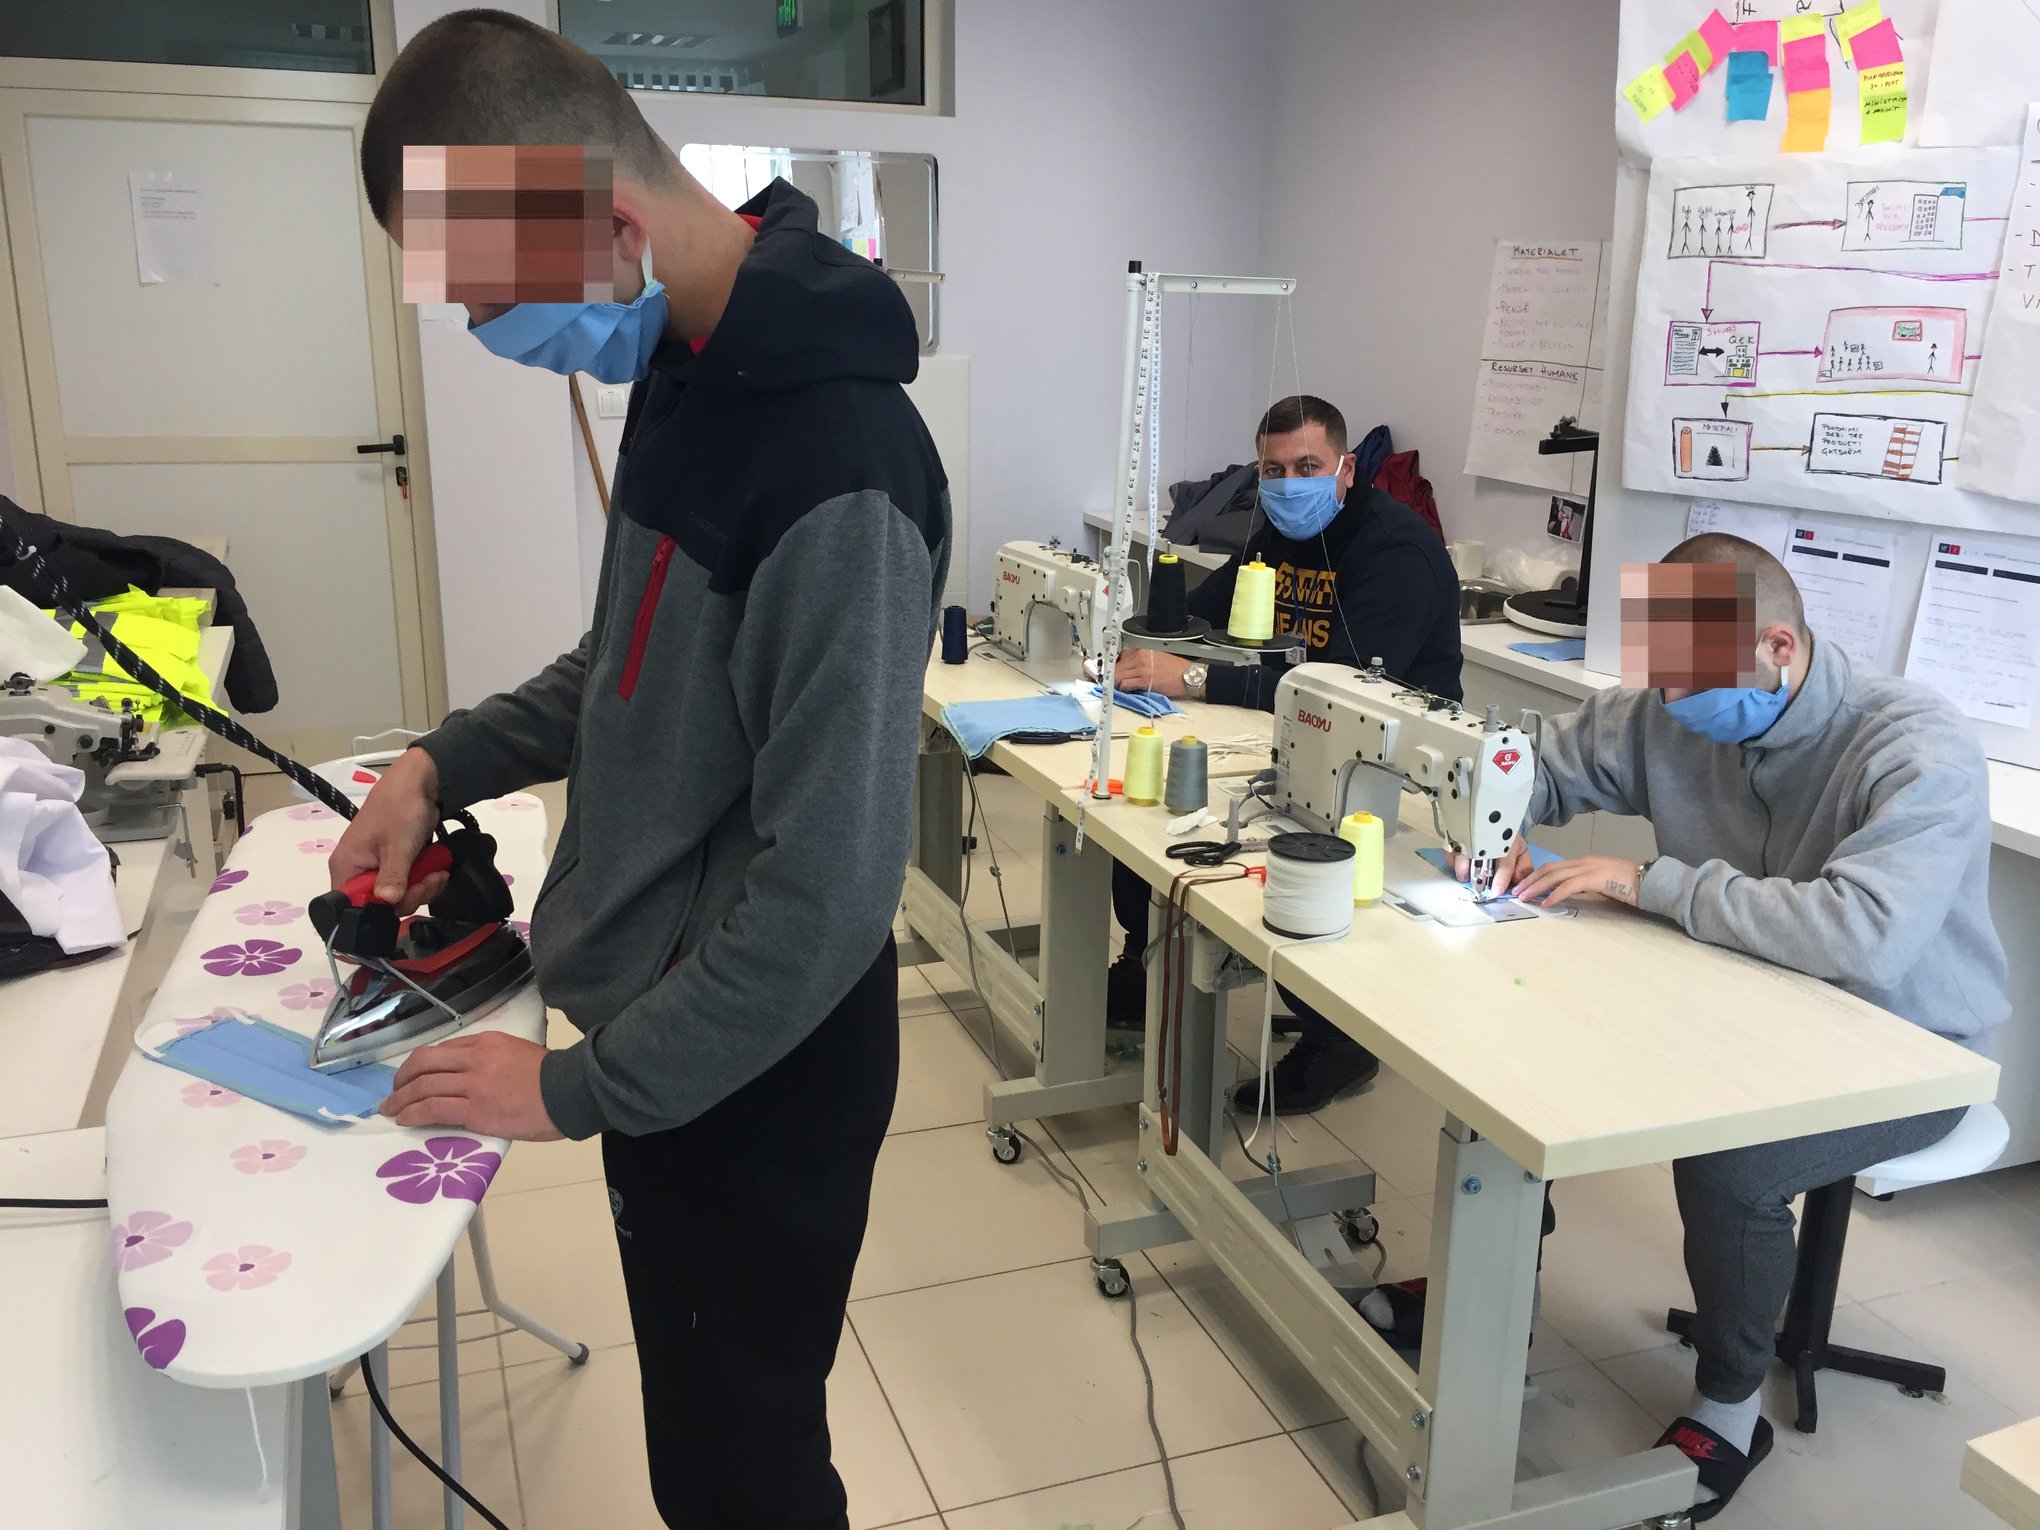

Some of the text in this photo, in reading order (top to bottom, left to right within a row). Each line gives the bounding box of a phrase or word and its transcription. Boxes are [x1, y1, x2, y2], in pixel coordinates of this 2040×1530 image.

[1513, 245, 1579, 257] MATERIALET
[1145, 309, 1152, 322] 30
[1540, 365, 1578, 381] HUMANE
[1297, 708, 1332, 733] BAOYU
